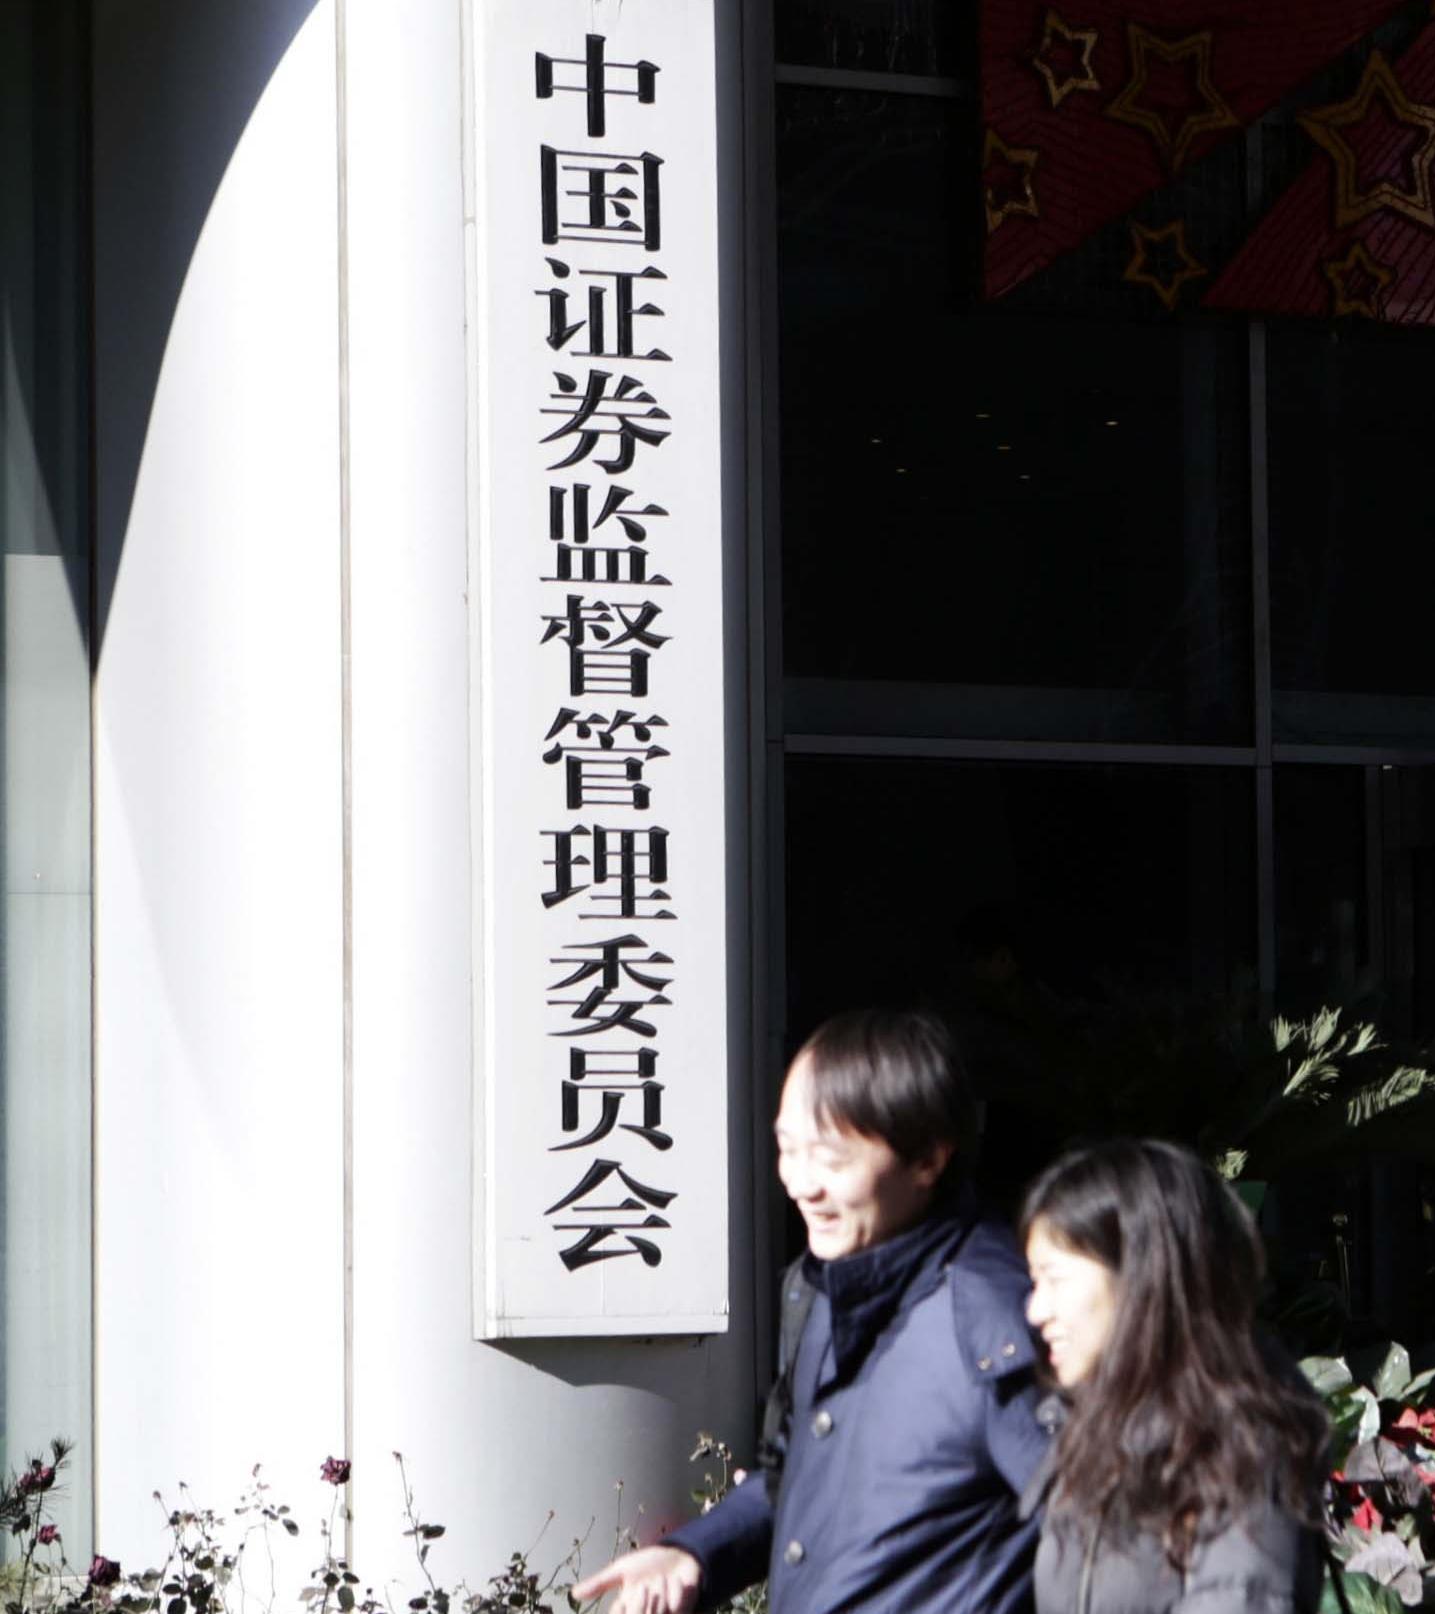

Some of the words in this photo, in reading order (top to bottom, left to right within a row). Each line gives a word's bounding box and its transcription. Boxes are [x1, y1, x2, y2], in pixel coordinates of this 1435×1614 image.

[535, 32, 677, 1272] 中国证券监督管理委员会
